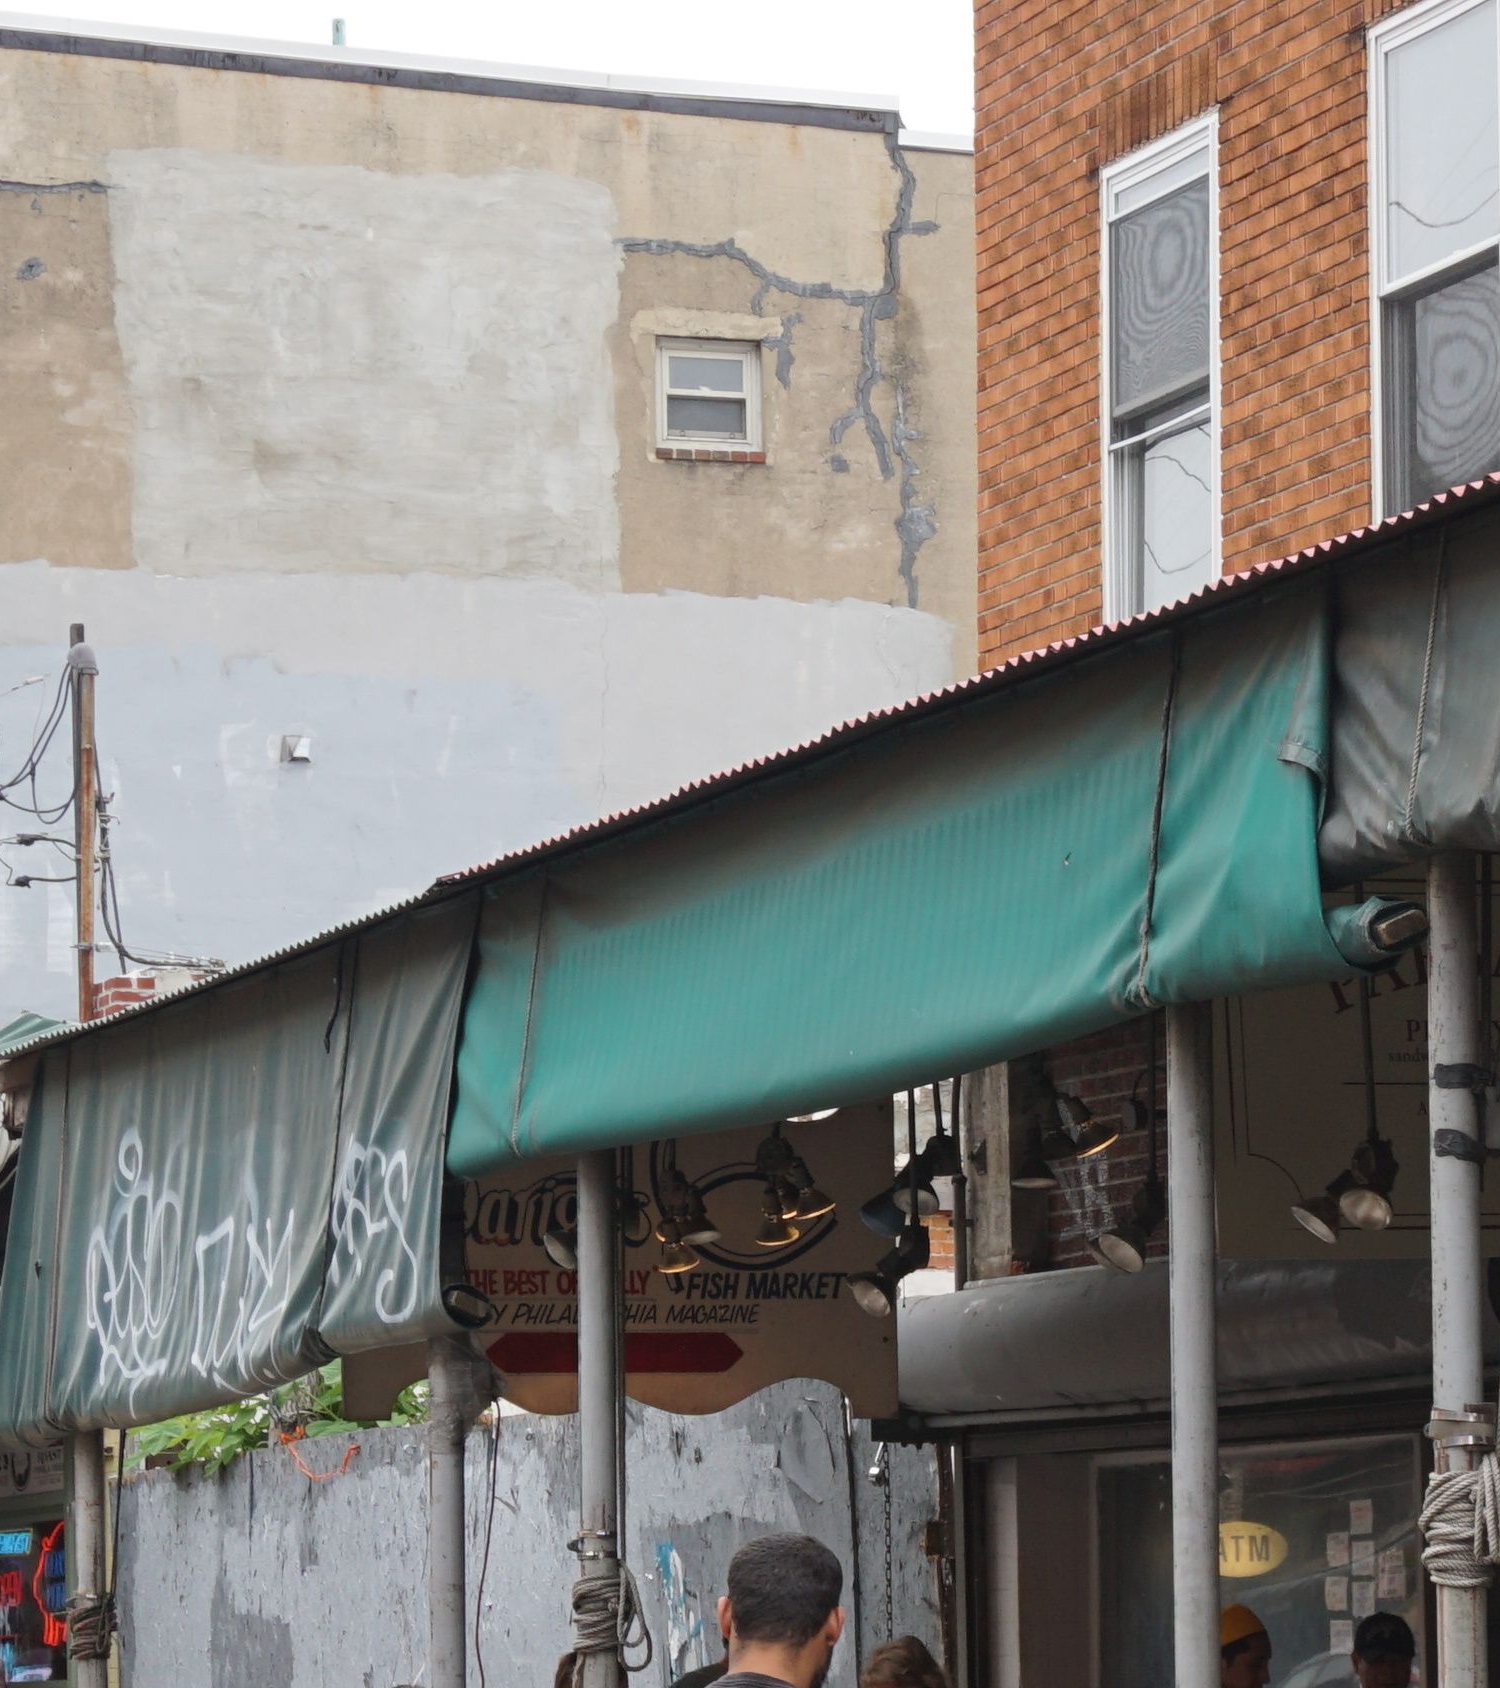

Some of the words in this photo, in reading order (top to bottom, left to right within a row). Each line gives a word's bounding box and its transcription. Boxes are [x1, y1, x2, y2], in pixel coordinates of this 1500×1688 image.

[503, 1271, 550, 1295] BEST
[686, 1272, 739, 1299] FISH
[744, 1272, 847, 1299] MARKET
[666, 1303, 760, 1325] MAGAZINE
